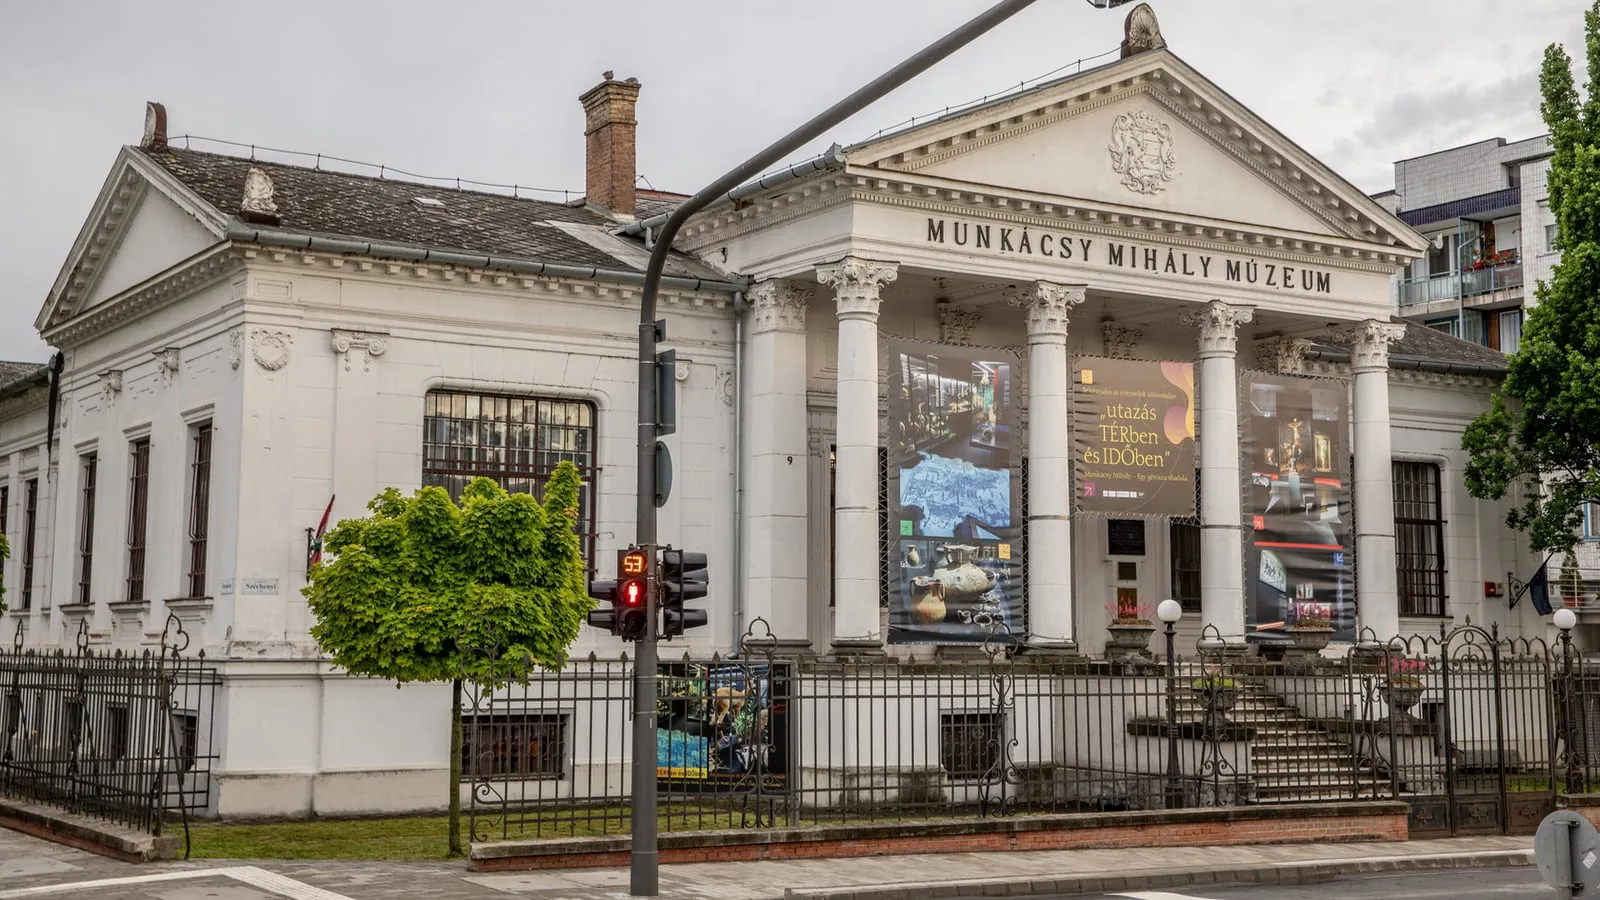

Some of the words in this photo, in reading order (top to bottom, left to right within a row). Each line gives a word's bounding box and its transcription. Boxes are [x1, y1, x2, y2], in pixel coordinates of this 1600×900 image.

[927, 218, 1092, 261] MUNKÁCSY
[1108, 242, 1212, 279] MIHÁLY
[1225, 256, 1331, 294] MÚZEUM
[1100, 403, 1157, 420] „utazás
[1099, 421, 1159, 445] TÉRben
[787, 455, 793, 465] 9
[1083, 446, 1100, 464] és
[623, 556, 642, 572] 53
